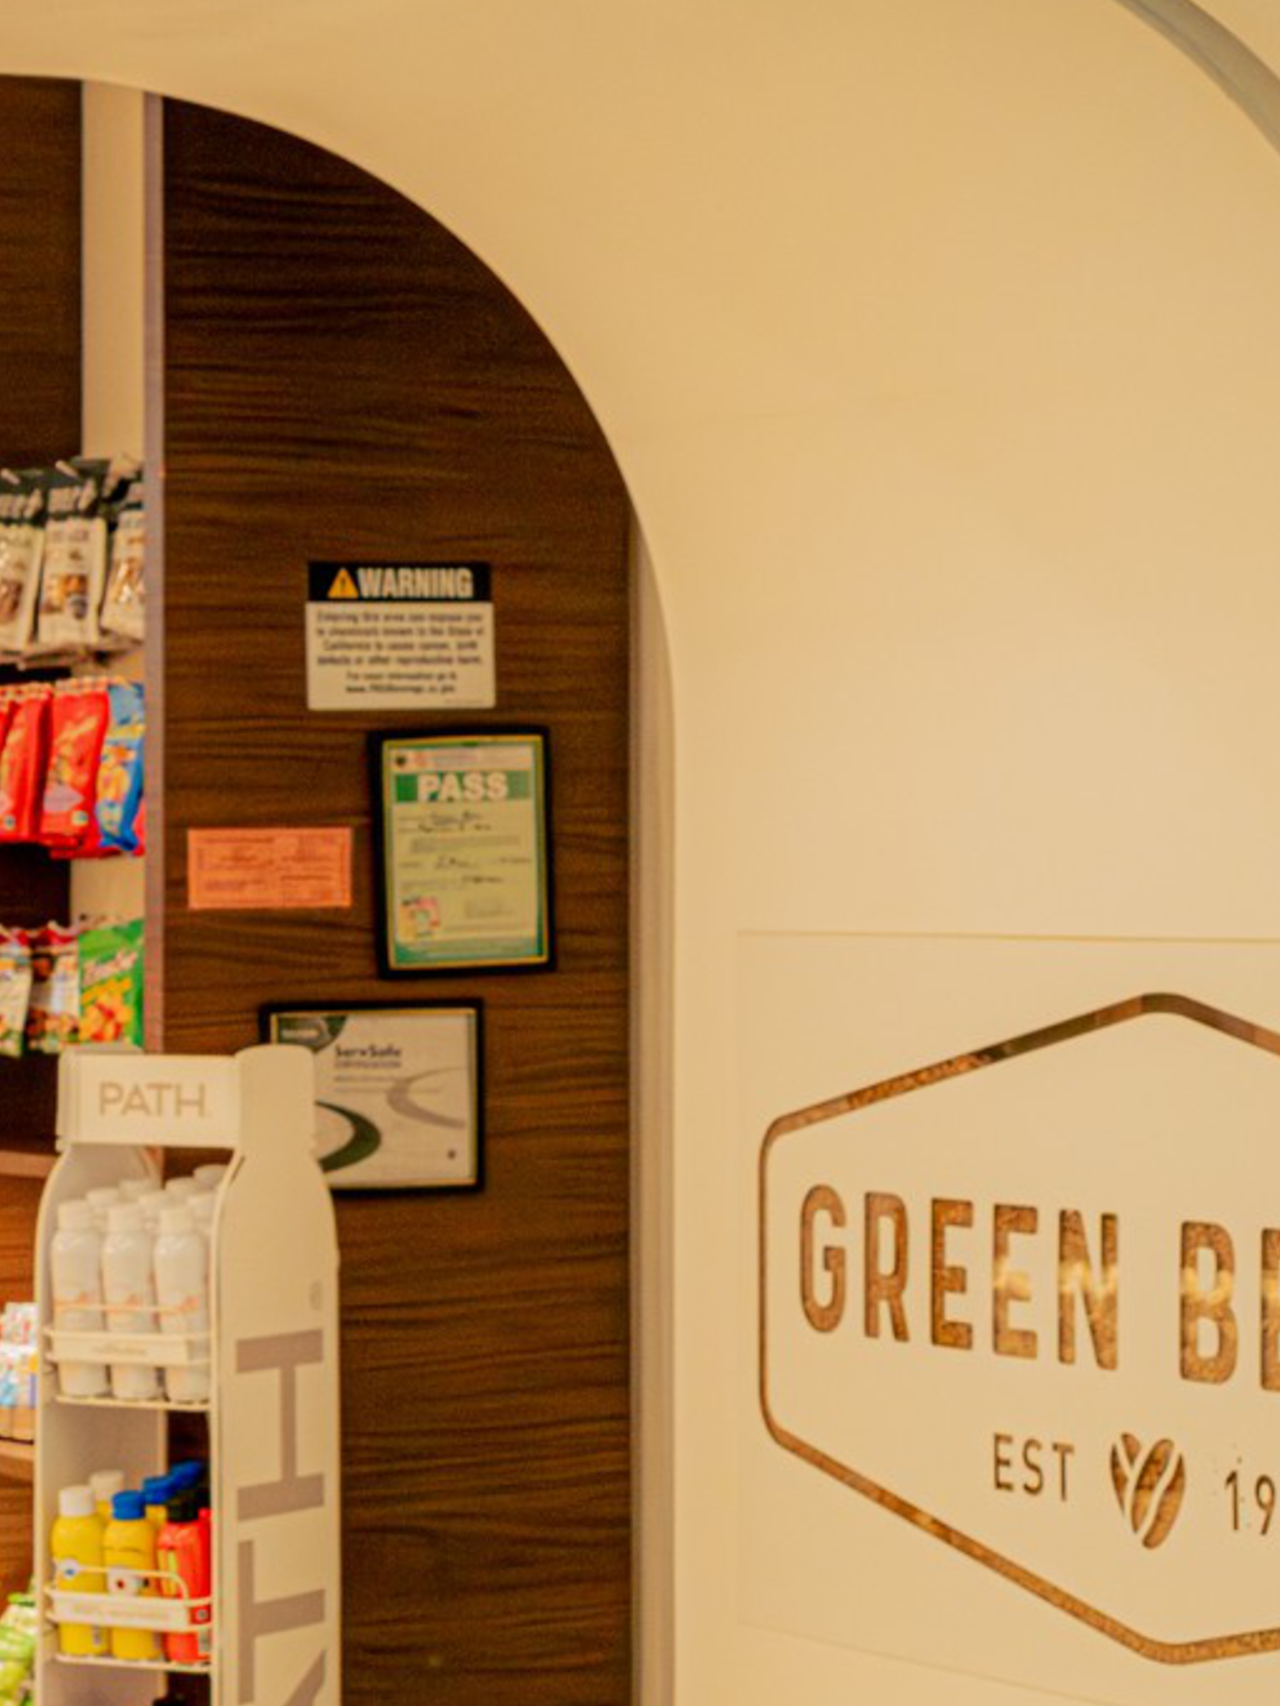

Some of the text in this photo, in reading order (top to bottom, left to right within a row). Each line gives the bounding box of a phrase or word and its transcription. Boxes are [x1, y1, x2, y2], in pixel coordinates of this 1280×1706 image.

[357, 567, 474, 599] WARNING
[417, 770, 510, 803] PASS
[99, 1080, 206, 1118] PATH
[798, 1183, 1121, 1373] GREEN
[992, 1432, 1077, 1503] EST
